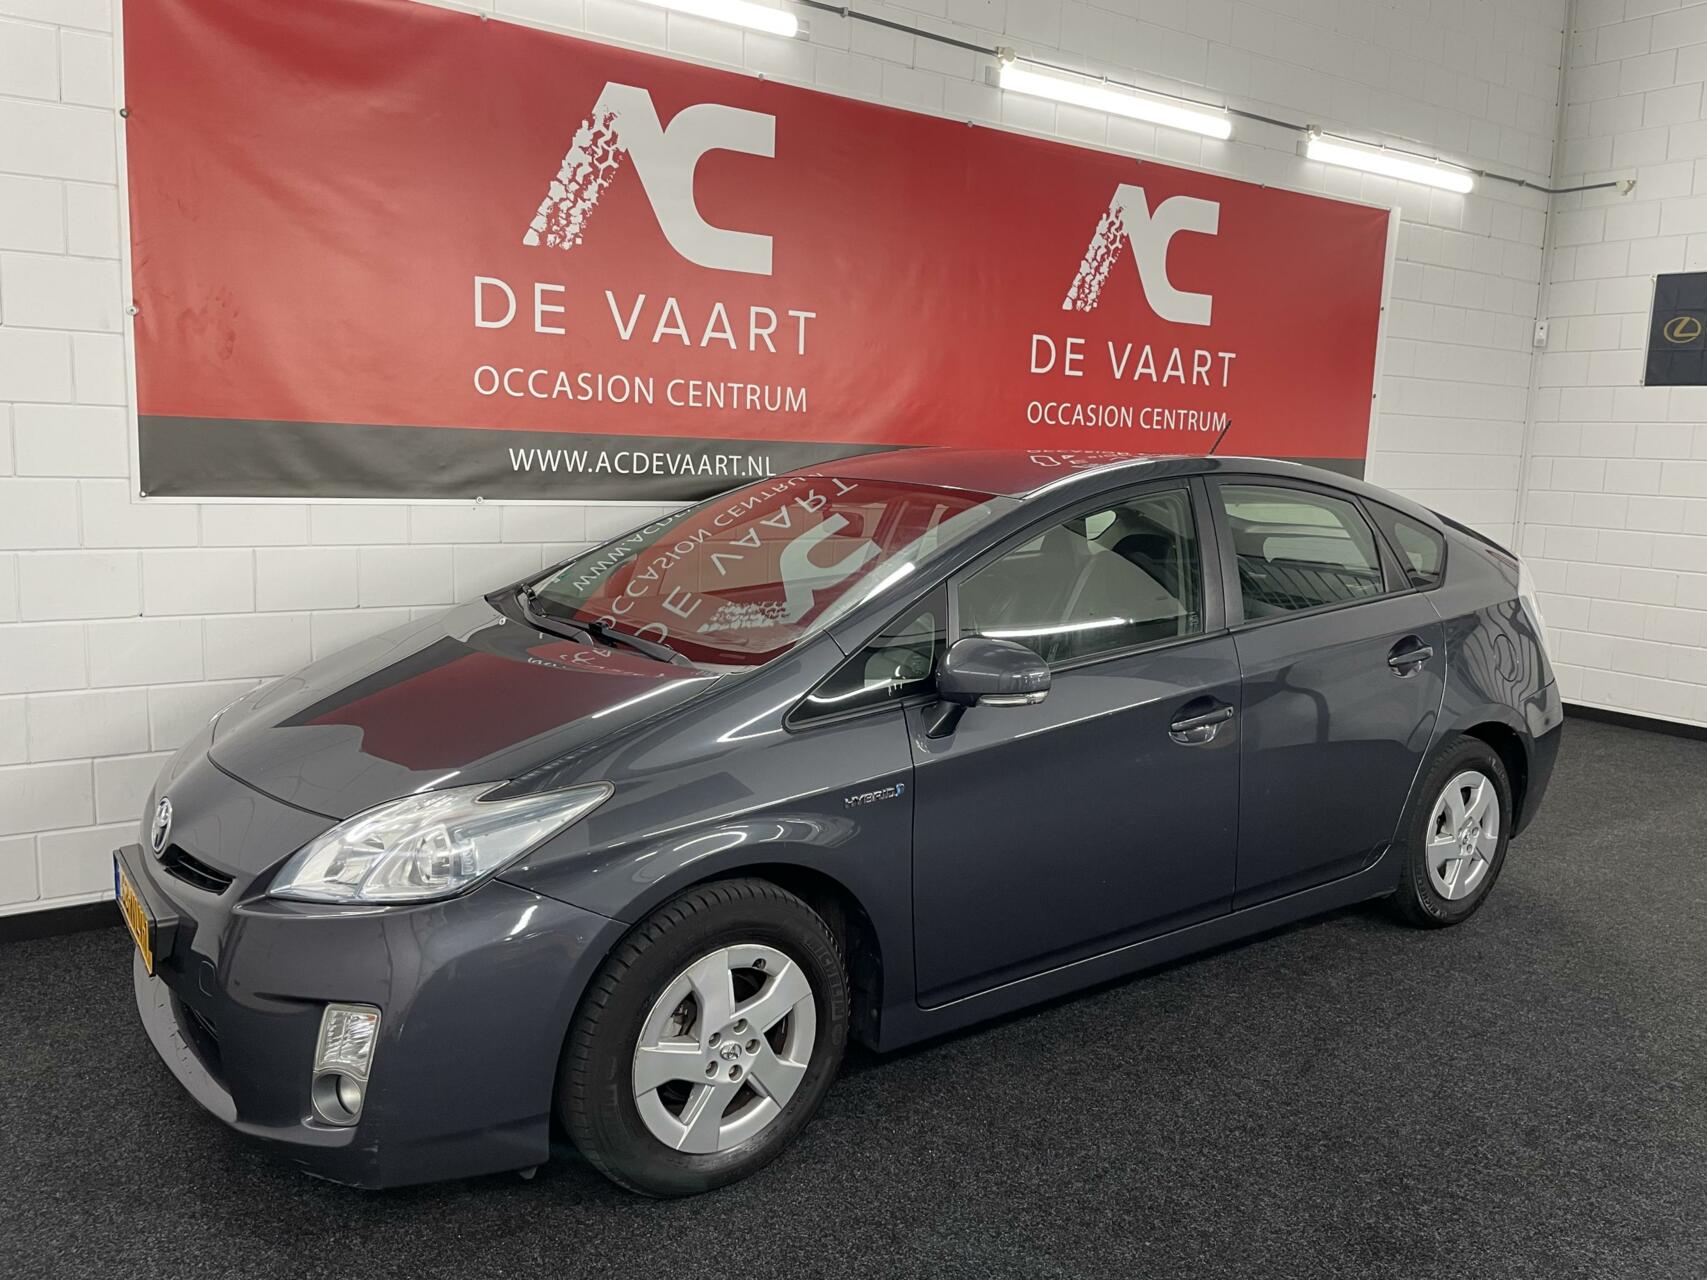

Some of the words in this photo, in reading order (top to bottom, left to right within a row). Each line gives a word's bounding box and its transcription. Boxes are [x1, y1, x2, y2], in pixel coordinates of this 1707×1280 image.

[522, 81, 776, 276] AC
[1062, 183, 1220, 326] AC
[473, 275, 566, 335] DE
[605, 290, 817, 355] VAART
[1030, 334, 1085, 377] DE
[1108, 341, 1237, 388] VAART
[473, 366, 655, 404] OCCASION
[667, 379, 808, 413] CENTRUM
[1027, 401, 1133, 428] OCCASION
[1140, 407, 1228, 432] CENTRUM
[509, 448, 776, 477] WWW.ACDEVAART.NL
[844, 787, 895, 809] HYBRID
